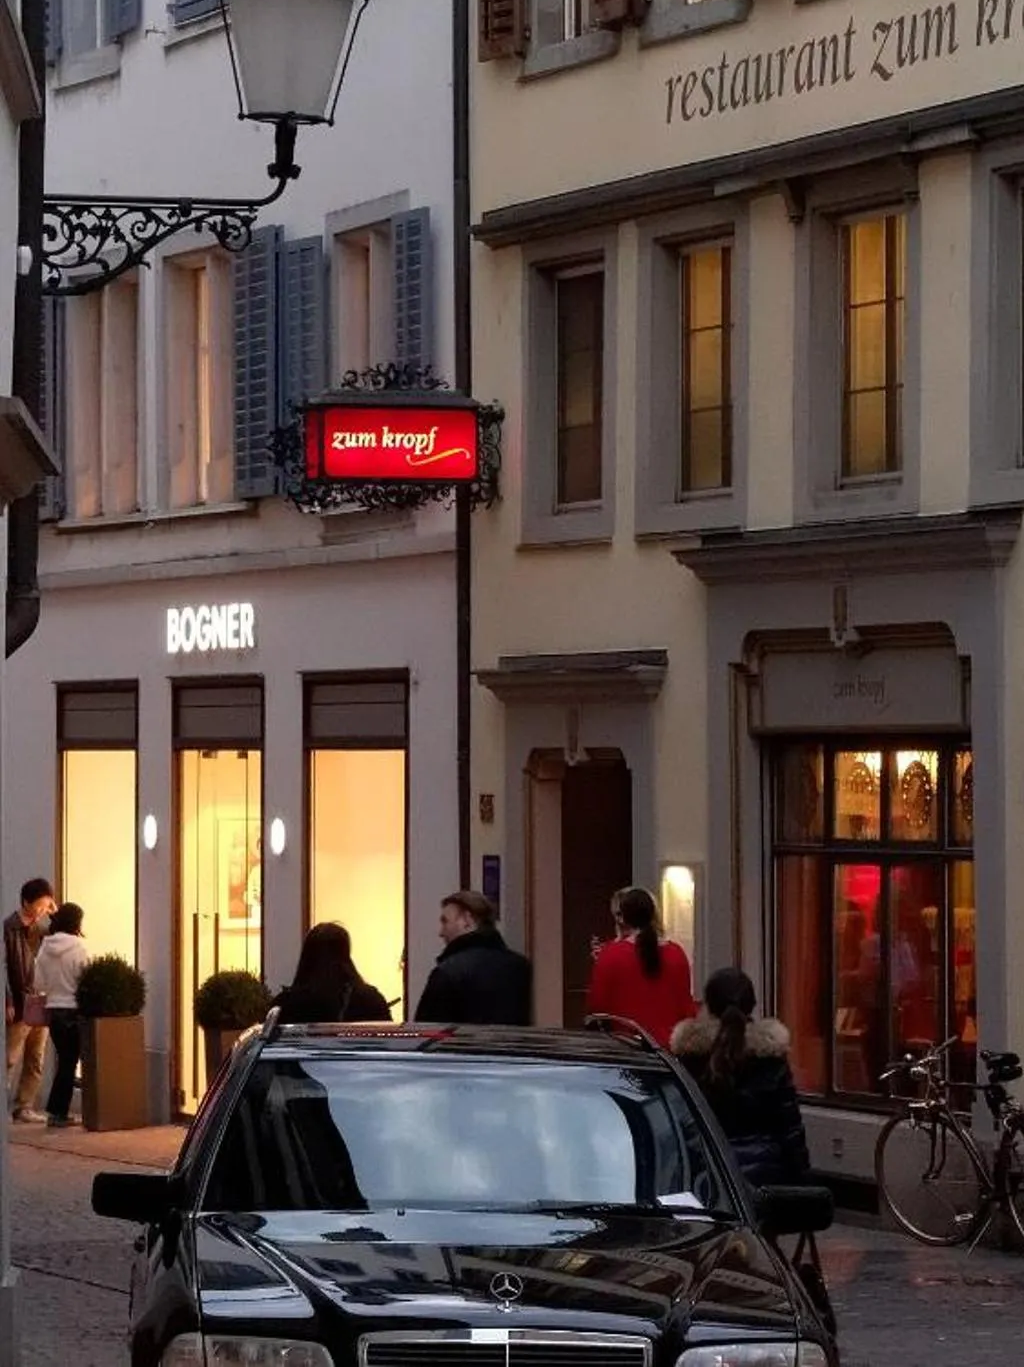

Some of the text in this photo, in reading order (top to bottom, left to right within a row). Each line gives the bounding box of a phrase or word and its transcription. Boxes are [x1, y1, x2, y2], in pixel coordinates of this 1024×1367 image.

[664, 15, 856, 124] restaurant
[870, 1, 958, 82] zum
[332, 426, 440, 455] zum kropf
[166, 602, 255, 654] BOGNER
